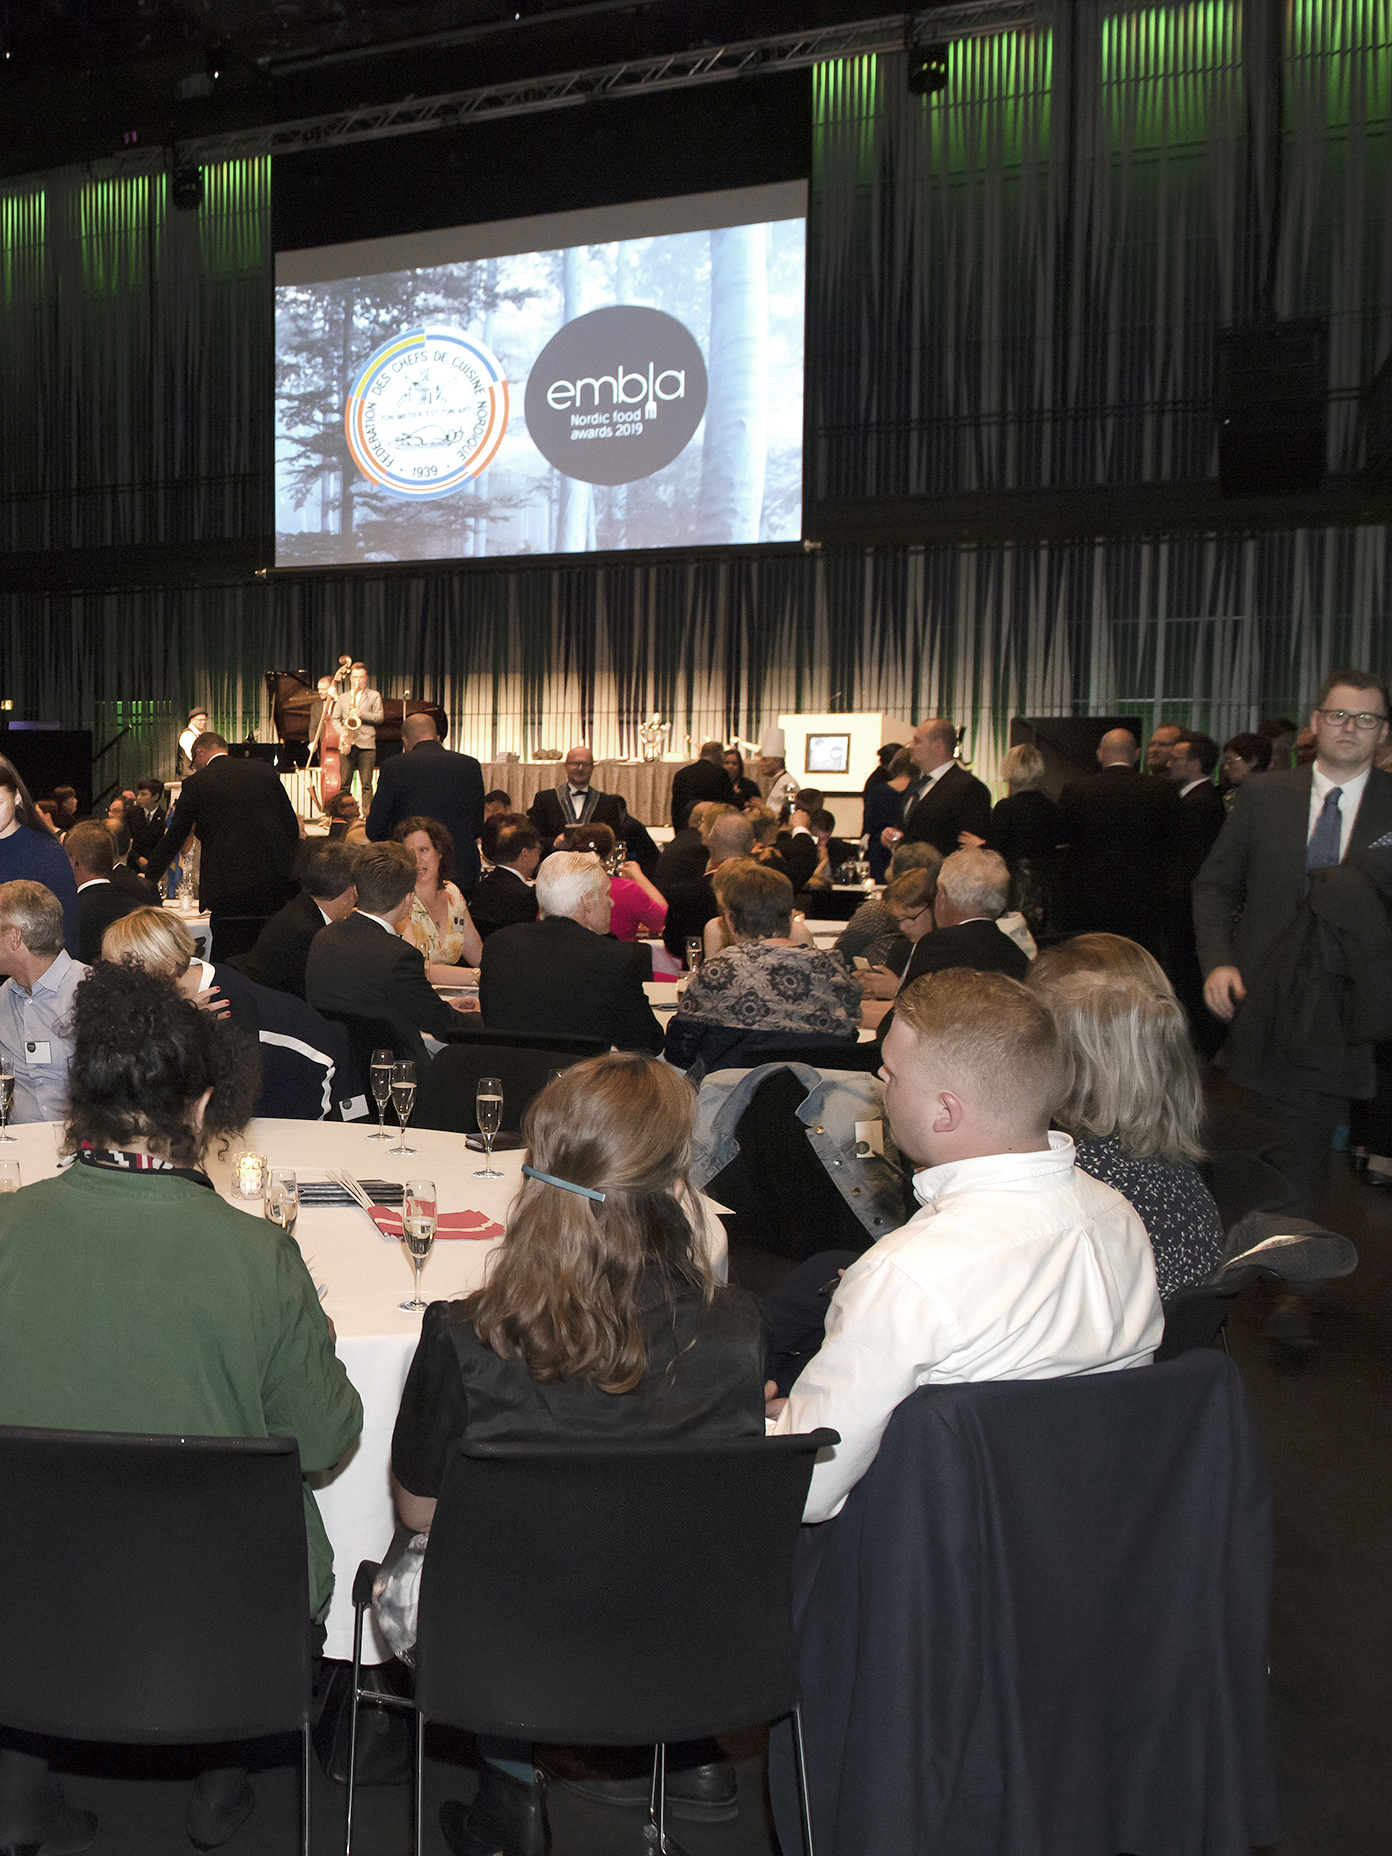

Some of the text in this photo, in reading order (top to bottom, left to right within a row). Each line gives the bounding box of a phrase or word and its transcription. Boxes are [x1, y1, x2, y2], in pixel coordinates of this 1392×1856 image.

[547, 362, 685, 420] embla
[365, 351, 487, 468] FEDERATION DES CHEFS DE CUISINE NORDIQUE
[570, 409, 642, 426] Nordic food
[570, 422, 643, 441] awards 2019
[412, 465, 438, 477] 1939
